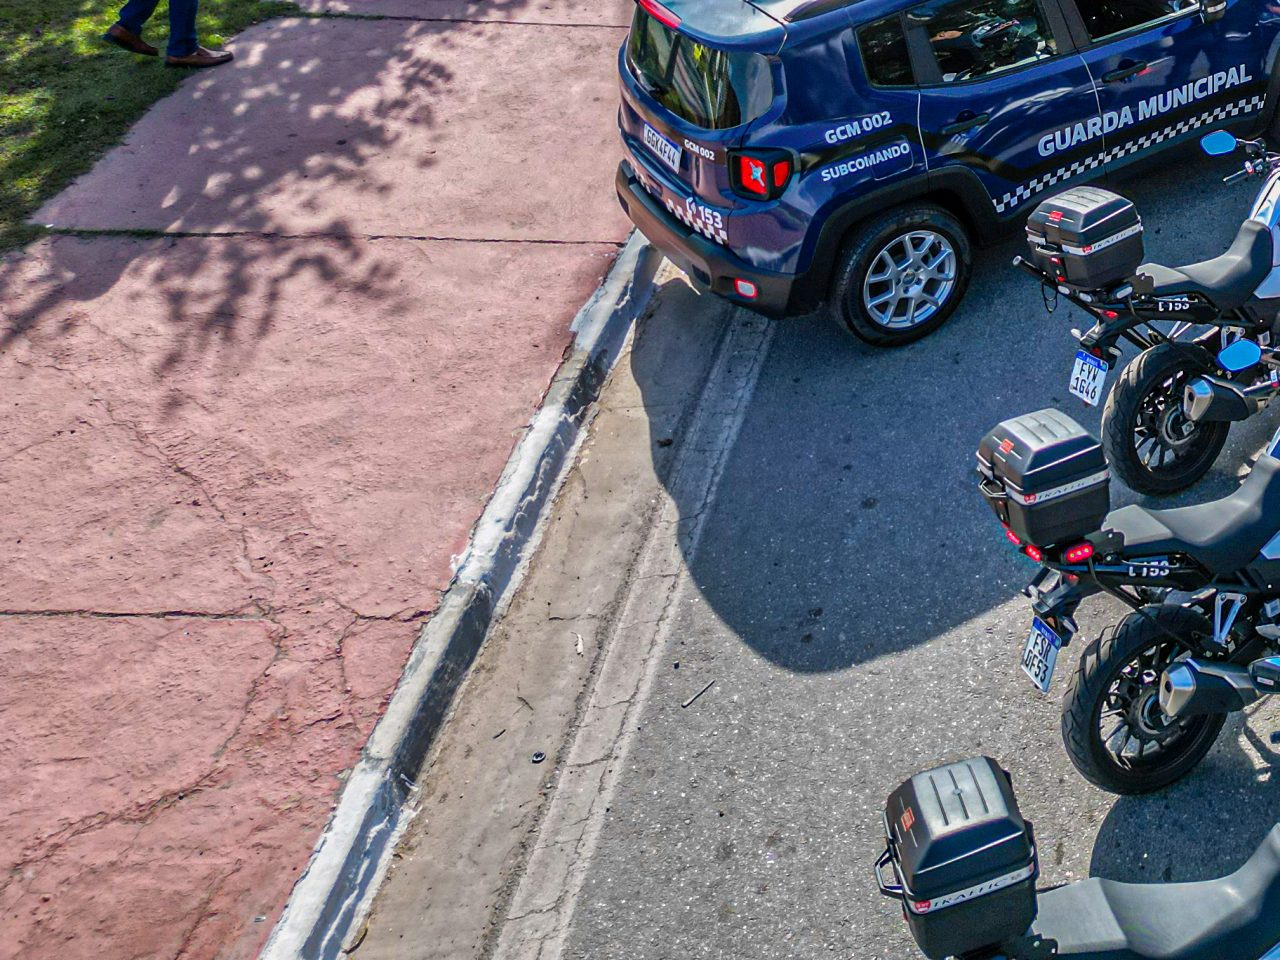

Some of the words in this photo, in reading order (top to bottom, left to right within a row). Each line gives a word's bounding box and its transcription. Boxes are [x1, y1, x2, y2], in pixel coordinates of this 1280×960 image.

[1037, 105, 1134, 158] GUARDA
[1138, 63, 1253, 121] MUNICIPAL
[824, 121, 862, 144] GCM
[862, 110, 893, 132] 002
[684, 138, 700, 154] GCM
[699, 147, 715, 161] 002
[821, 142, 910, 182] SUBCOMANDO
[698, 205, 723, 229] 153
[1072, 375, 1098, 401] 1G46
